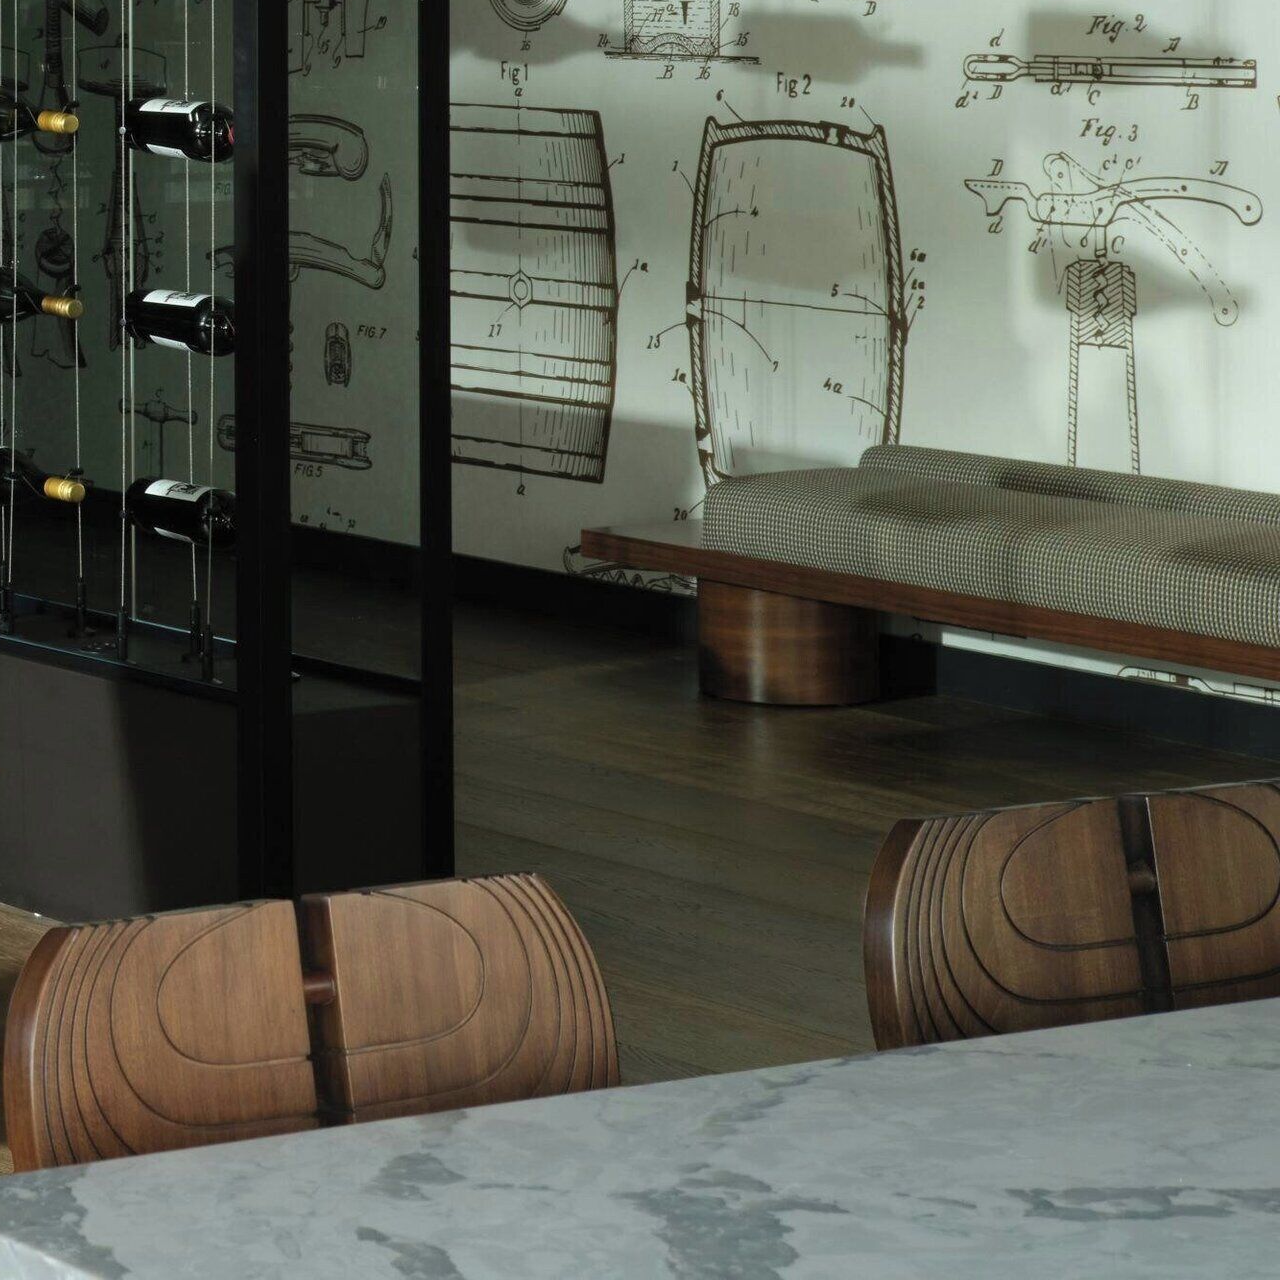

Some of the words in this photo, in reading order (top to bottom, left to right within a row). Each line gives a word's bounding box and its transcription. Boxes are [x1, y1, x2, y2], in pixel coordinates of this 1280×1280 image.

[1134, 14, 1148, 32] 2
[989, 28, 1005, 48] d
[802, 74, 812, 95] 2
[1126, 123, 1139, 142] 3
[988, 158, 1004, 177] D
[750, 207, 759, 218] 4
[987, 215, 1003, 234] d
[831, 283, 838, 298] 5
[917, 296, 925, 310] 2
[488, 323, 502, 338] 17
